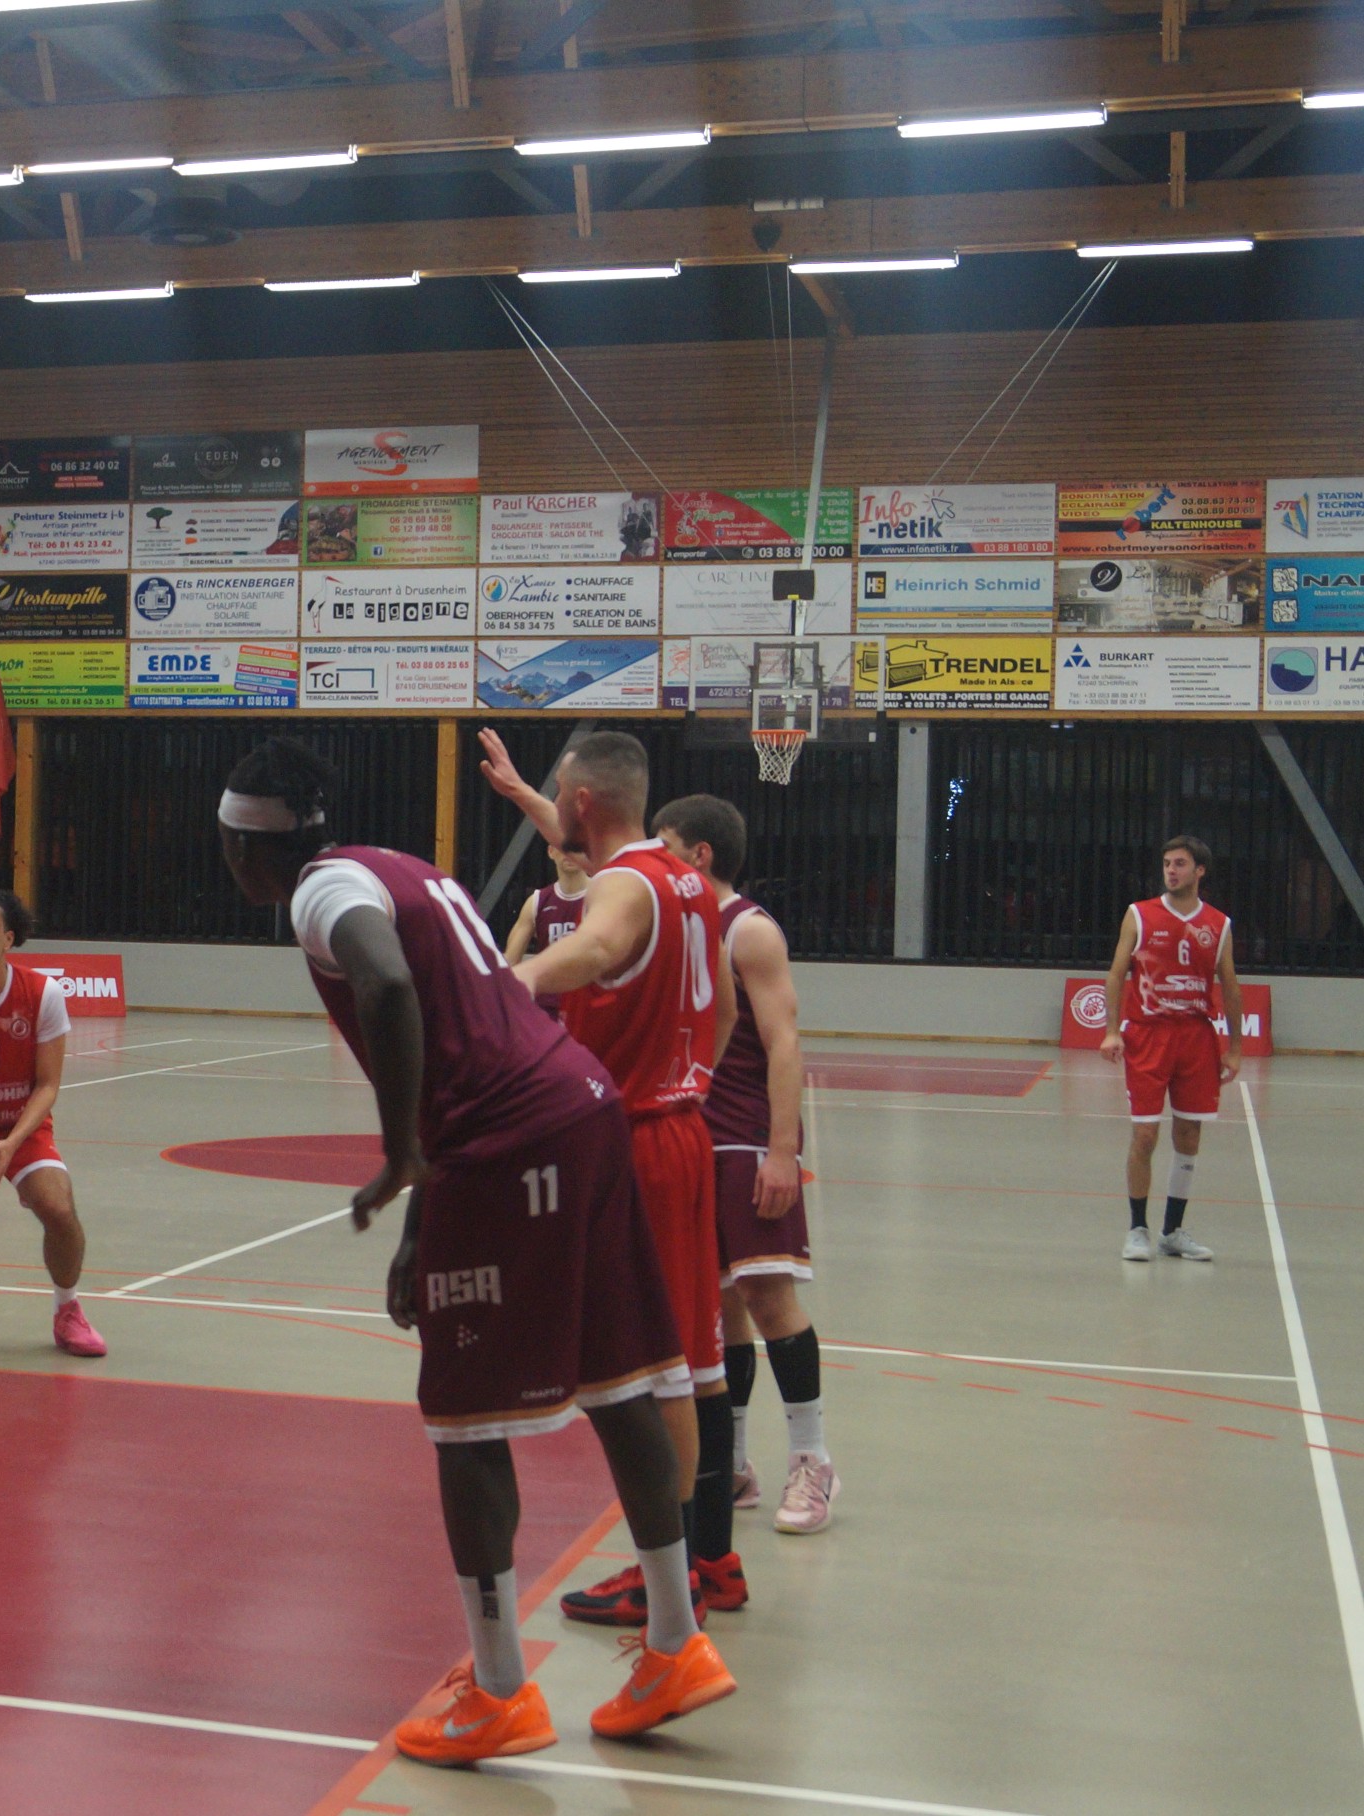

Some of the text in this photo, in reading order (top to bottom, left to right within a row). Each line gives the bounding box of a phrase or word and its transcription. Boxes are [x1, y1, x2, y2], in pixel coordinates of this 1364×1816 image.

[51, 461, 120, 471] 06 86 32 40 02
[1177, 480, 1238, 488] INSTALLATION
[734, 490, 761, 499] Ouvert
[1061, 491, 1145, 501] SONORISATION
[1316, 492, 1363, 500] STATION
[361, 498, 474, 509] FROMAGERIE STEINMETZ
[492, 496, 598, 513] Paul KARCHER
[860, 490, 917, 528] Info
[13, 509, 108, 521] Peinture Steinmetz
[71, 521, 97, 530] peintre
[403, 525, 412, 533] 12
[491, 521, 593, 531] BOULANGERIE PATISSERIE
[1151, 519, 1243, 530] KALTENHOUSE
[491, 530, 587, 540] CHOCOLATIER SALON DE
[46, 541, 57, 549] 06
[87, 540, 98, 548] 23
[101, 540, 113, 548] 42
[881, 543, 1049, 555] www.infonetik.fr 03 88 180 180
[1062, 541, 1256, 554] www.robertmeyersonorisation.fr
[673, 550, 707, 561] emporter
[758, 546, 845, 558] 03 88 00
[190, 558, 234, 566] BISCHWILLER
[176, 578, 296, 590] Ets RINCKENBERGER
[573, 577, 634, 587] CHAUFFAGE
[866, 576, 885, 593] HS
[895, 577, 1041, 591] Heinrich Schmid
[180, 591, 285, 601] INSTALLATION SANITAIRE
[334, 584, 467, 598] Restaurant à Drusenheim
[573, 593, 627, 602] SANITAIRE
[206, 602, 258, 611] CHAUFFAGE
[214, 611, 250, 620] SOLAIRE
[485, 611, 554, 622] OBERHOFFEN
[572, 608, 643, 619] CREATION DE
[483, 621, 555, 632] 06 84 58 34 75
[572, 618, 657, 629] SALLE DE BAINS
[304, 643, 470, 655] TERRAZZO BÉTON POLI ENDUITS MINÉRAUX
[1099, 653, 1155, 661] BURKART
[148, 654, 212, 672] EMDE
[396, 660, 470, 669] Tél. 03 88 05 65
[928, 658, 1050, 673] TRENDEL
[310, 672, 341, 689] TCI
[395, 682, 468, 690] 67410 DRUSENHEIM
[959, 677, 997, 686] Made in
[708, 688, 734, 697] 67240
[910, 692, 1050, 701] VOLETS PORTES DE GARAGE
[247, 695, 255, 706] 03
[670, 698, 689, 707] TEL.
[913, 701, 1048, 710] 03 88 73 38 00 www.trendel.alsace
[423, 877, 509, 976] 11
[1177, 938, 1192, 966] 6
[521, 1164, 559, 1218] 11
[426, 1264, 503, 1312] ASA
